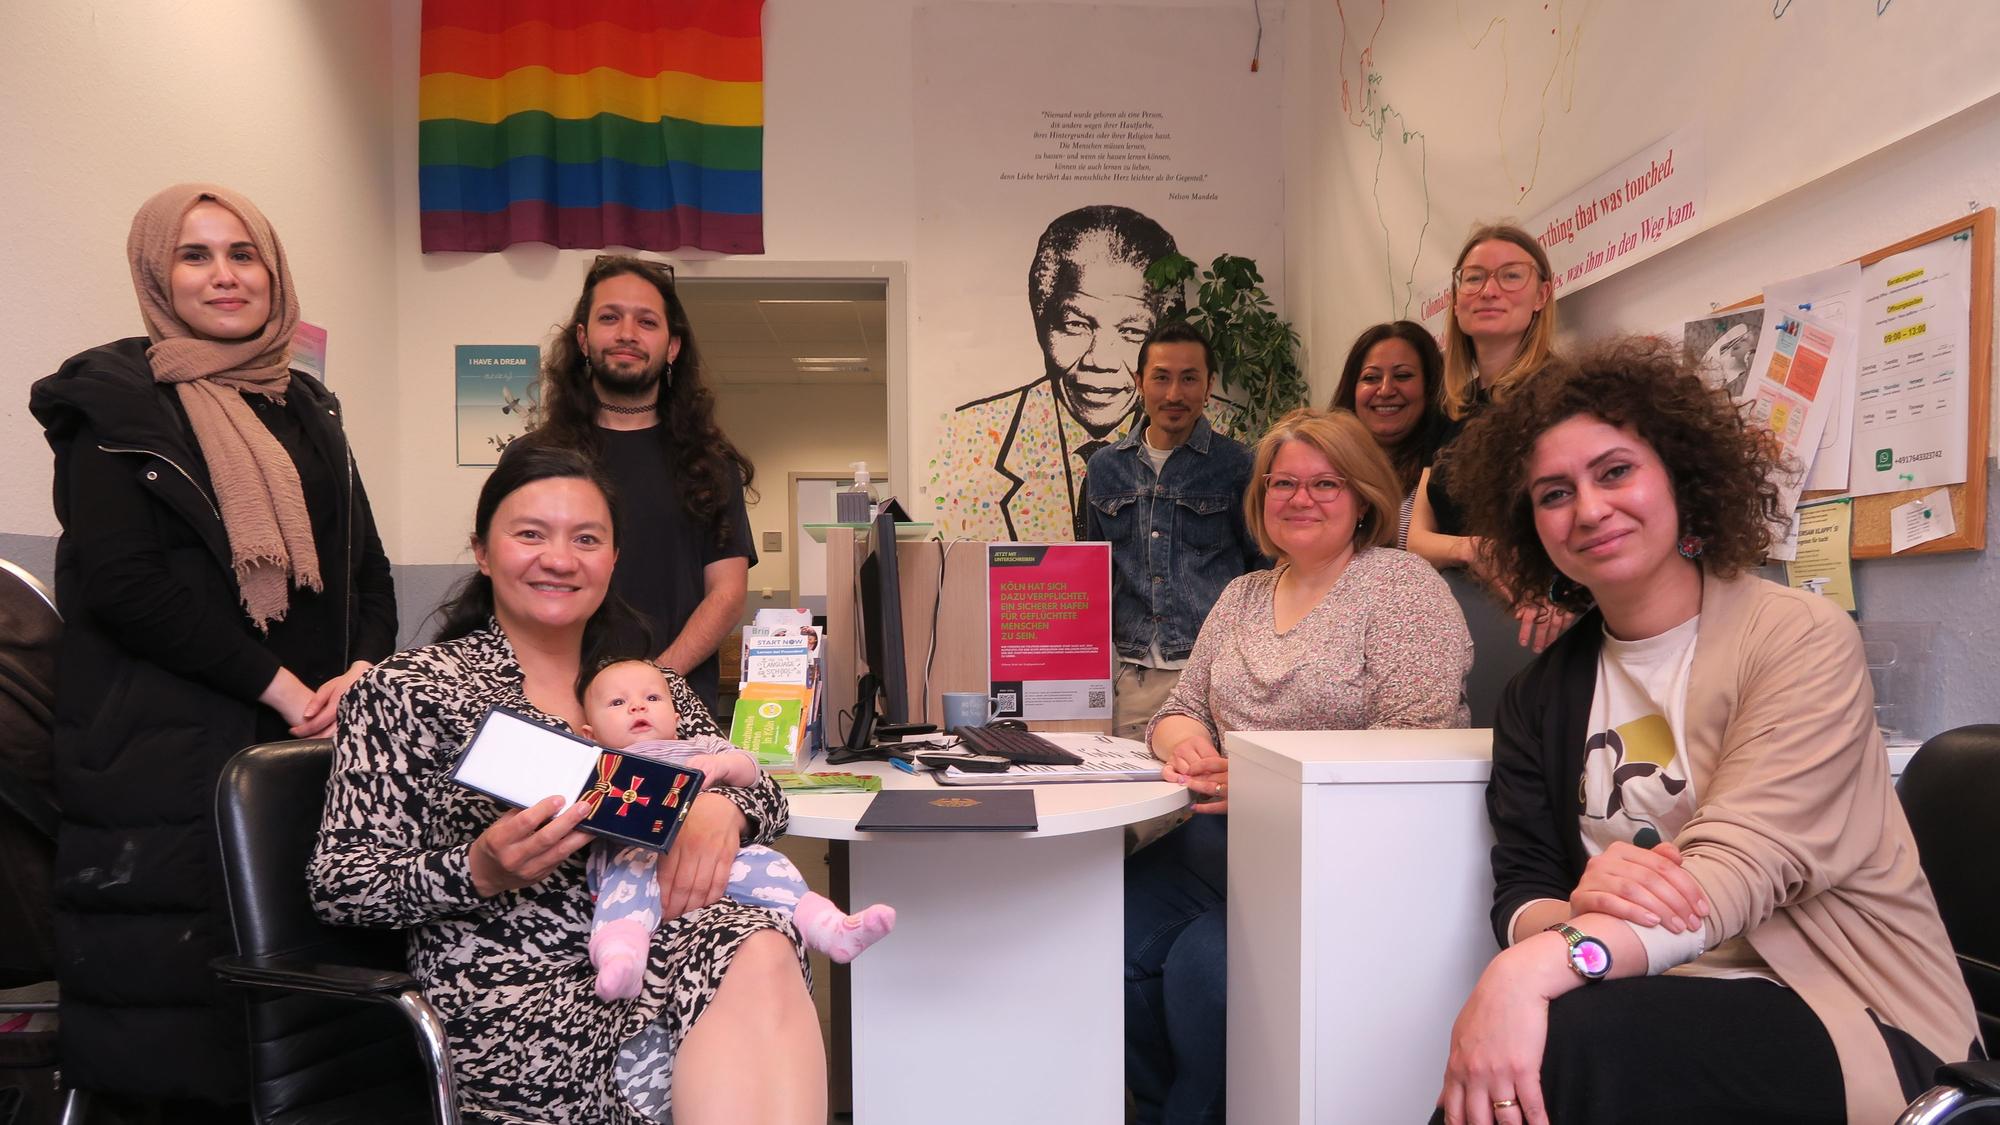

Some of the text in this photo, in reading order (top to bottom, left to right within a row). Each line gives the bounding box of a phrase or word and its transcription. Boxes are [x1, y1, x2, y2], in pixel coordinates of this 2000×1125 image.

[1093, 111, 1117, 120] geboren
[1062, 121, 1082, 129] andere
[1104, 121, 1118, 129] ihrer
[1050, 132, 1095, 140] Hintergrundes
[1128, 132, 1153, 141] Religion
[1054, 162, 1077, 170] können
[1088, 162, 1102, 170] auch
[1104, 162, 1122, 170] lernen
[1000, 172, 1014, 180] denn
[1017, 172, 1034, 180] Liebe
[1074, 172, 1111, 180] menschliche
[1113, 173, 1129, 181] Herz
[1575, 197, 1599, 232] that
[1600, 188, 1623, 216] was
[1625, 149, 1674, 203] touched.
[1567, 262, 1584, 283] was
[1584, 250, 1604, 274] ihm
[1605, 240, 1616, 264] in
[1618, 232, 1637, 257] den
[1641, 216, 1664, 245] Weg
[1665, 201, 1695, 232] kam.
[1884, 331, 1901, 344] 09:00
[1001, 581, 1067, 591] KÖLN HAT SICH
[1001, 592, 1089, 601] DAZU VERPFLICHTET,
[1001, 601, 1088, 611] EIN SICHERER HAFEN
[1001, 611, 1078, 620] FÜR GEFLÜCHTETE
[1001, 622, 1049, 630] MENSCHEN
[1001, 632, 1038, 640] ZU SEIN.
